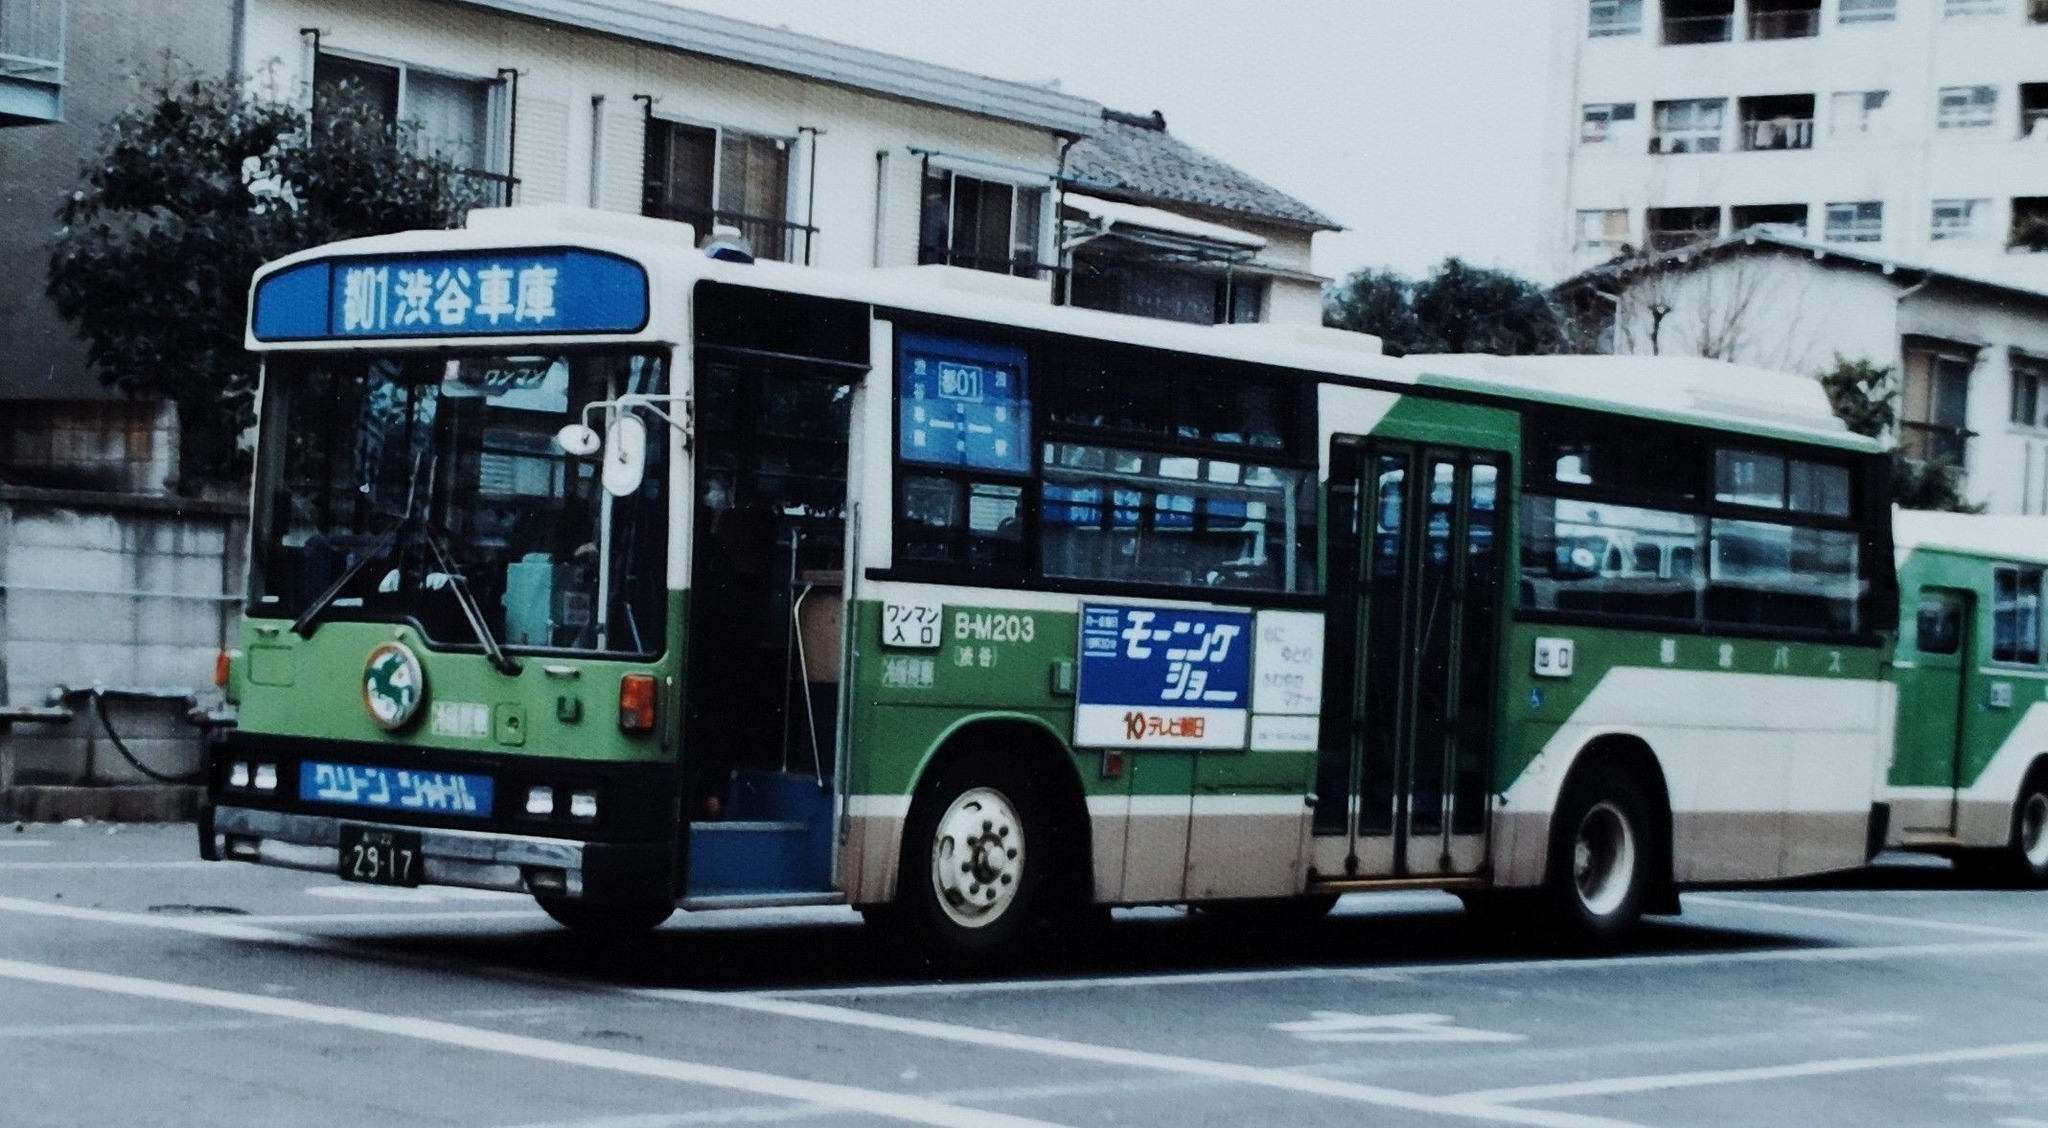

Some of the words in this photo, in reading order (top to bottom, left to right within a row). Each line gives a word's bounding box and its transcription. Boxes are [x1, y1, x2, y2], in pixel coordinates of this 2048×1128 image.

[394, 264, 558, 325] 渋谷車庫
[887, 604, 939, 624] ワンマン
[955, 611, 1035, 643] B-M203
[892, 625, 933, 644] 入口
[1160, 661, 1238, 702] ショー
[1123, 711, 1147, 740] 10
